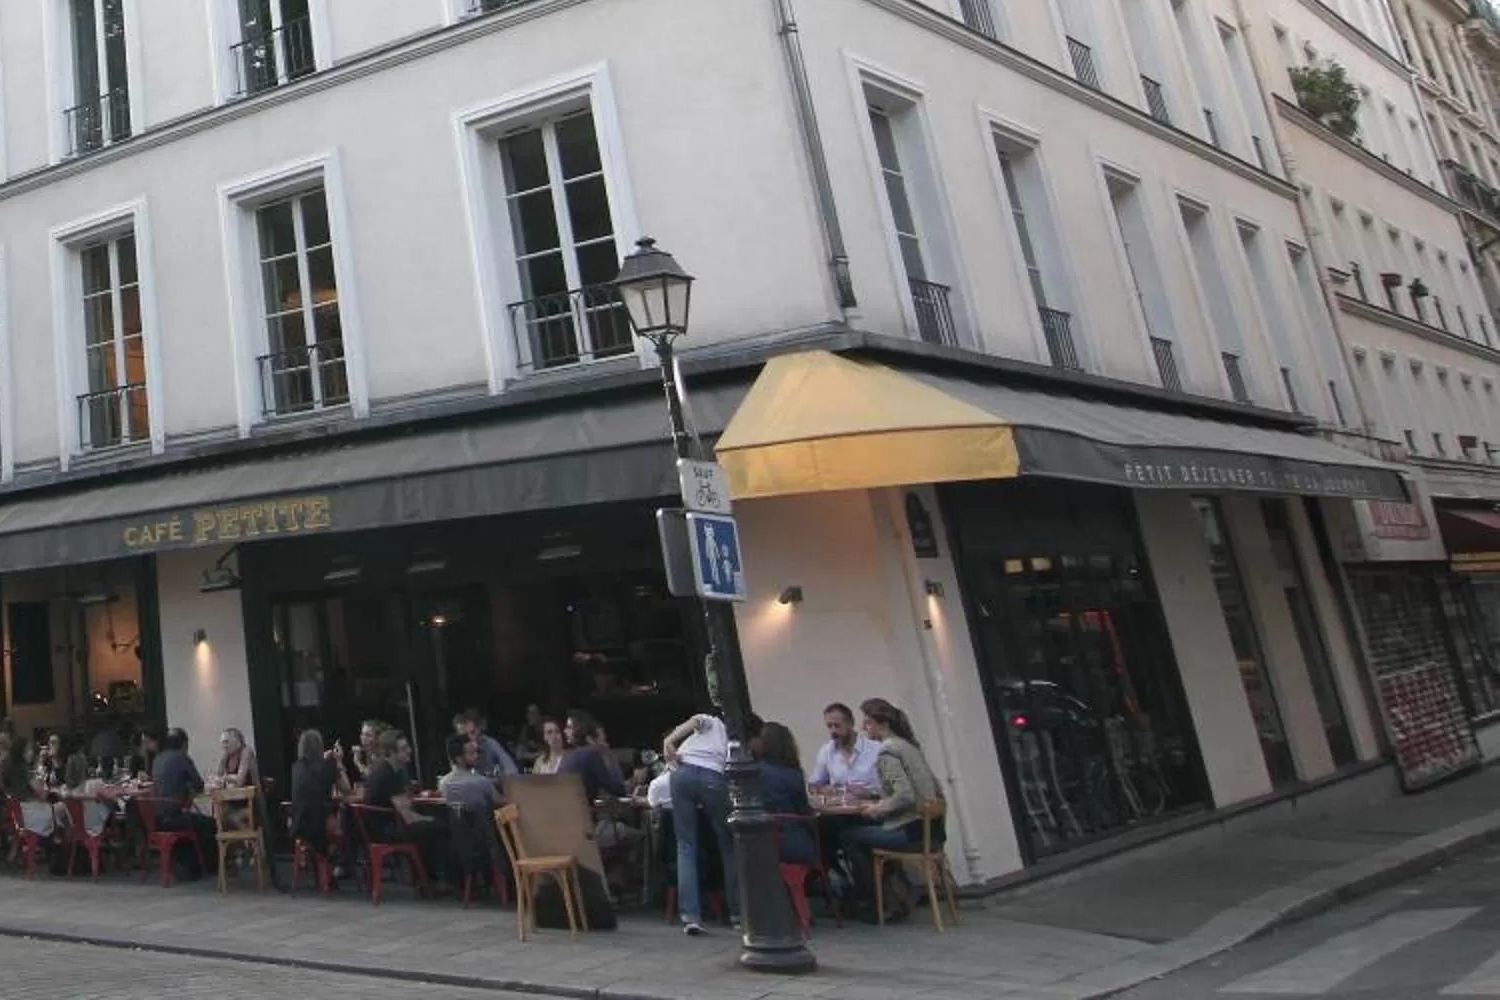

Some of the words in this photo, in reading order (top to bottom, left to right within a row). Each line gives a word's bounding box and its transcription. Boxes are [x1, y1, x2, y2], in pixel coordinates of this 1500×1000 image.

[1124, 463, 1173, 481] PETIT
[124, 515, 183, 547] CAFÉ
[192, 496, 330, 543] PETITE
